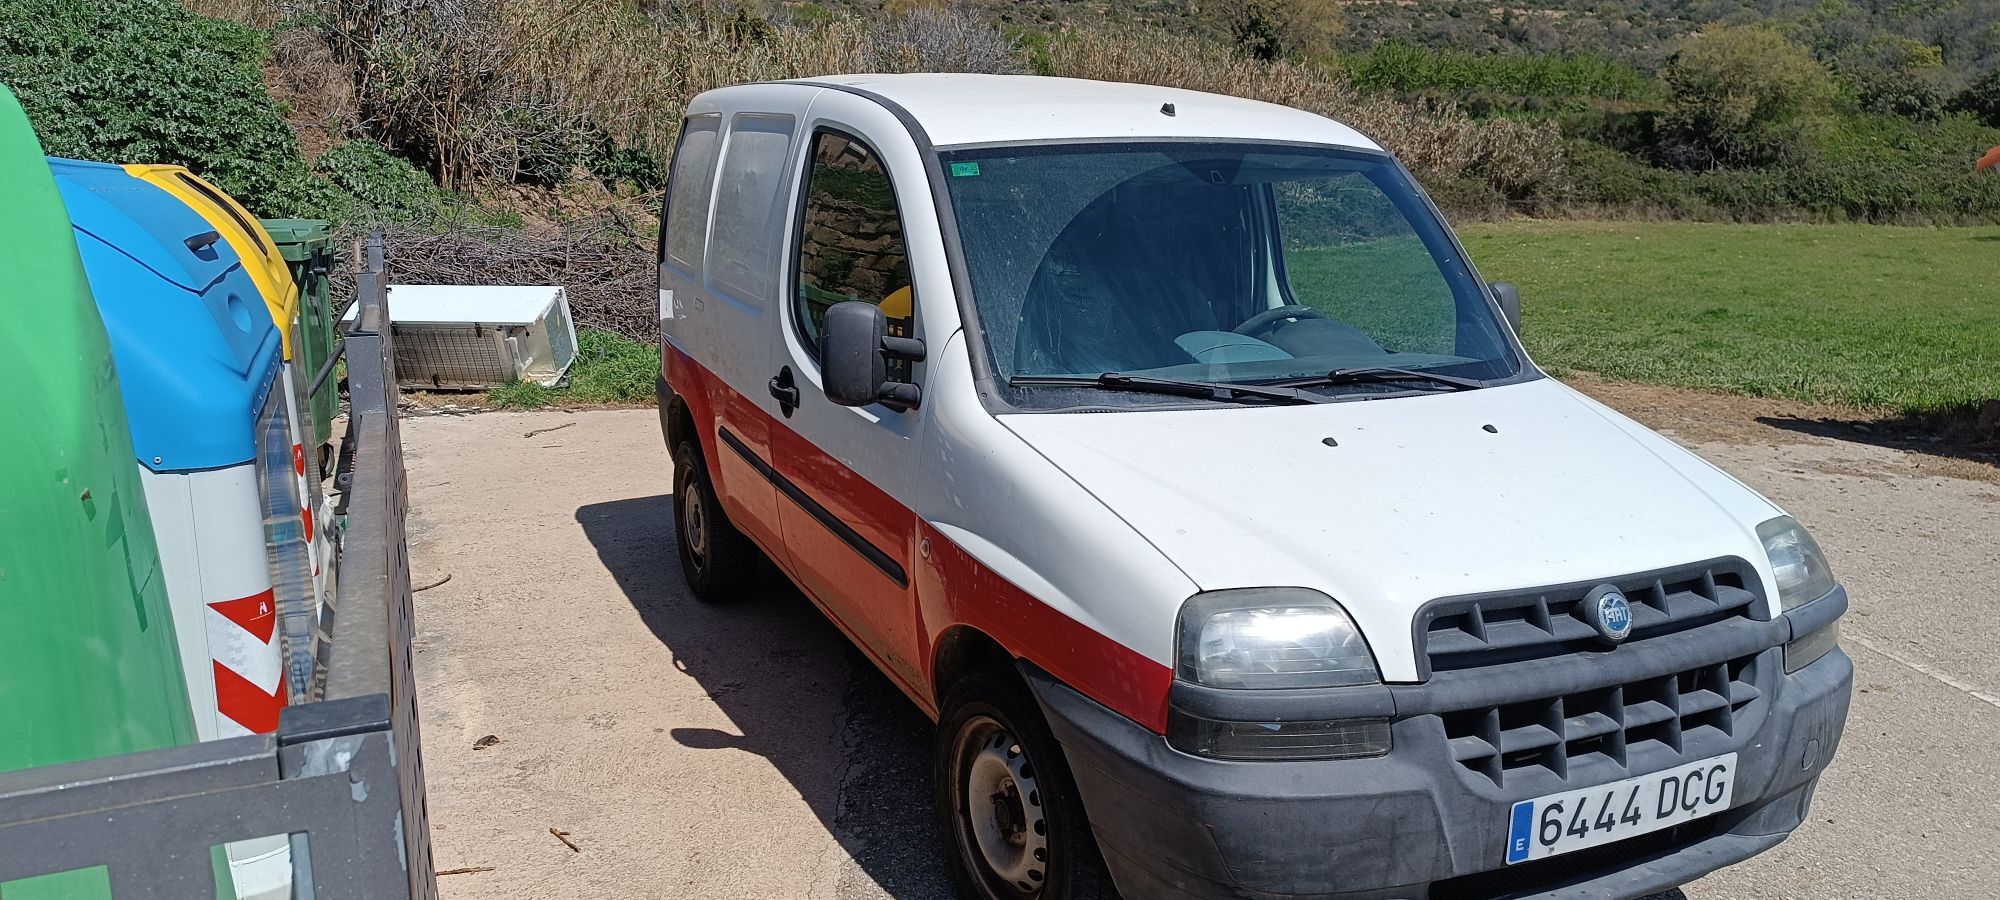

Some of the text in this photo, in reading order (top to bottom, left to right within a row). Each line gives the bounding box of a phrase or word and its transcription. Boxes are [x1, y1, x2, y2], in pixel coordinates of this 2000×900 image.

[1603, 606, 1627, 625] FIAT
[1539, 764, 1727, 846] 6444 DCG
[1515, 837, 1525, 851] E
